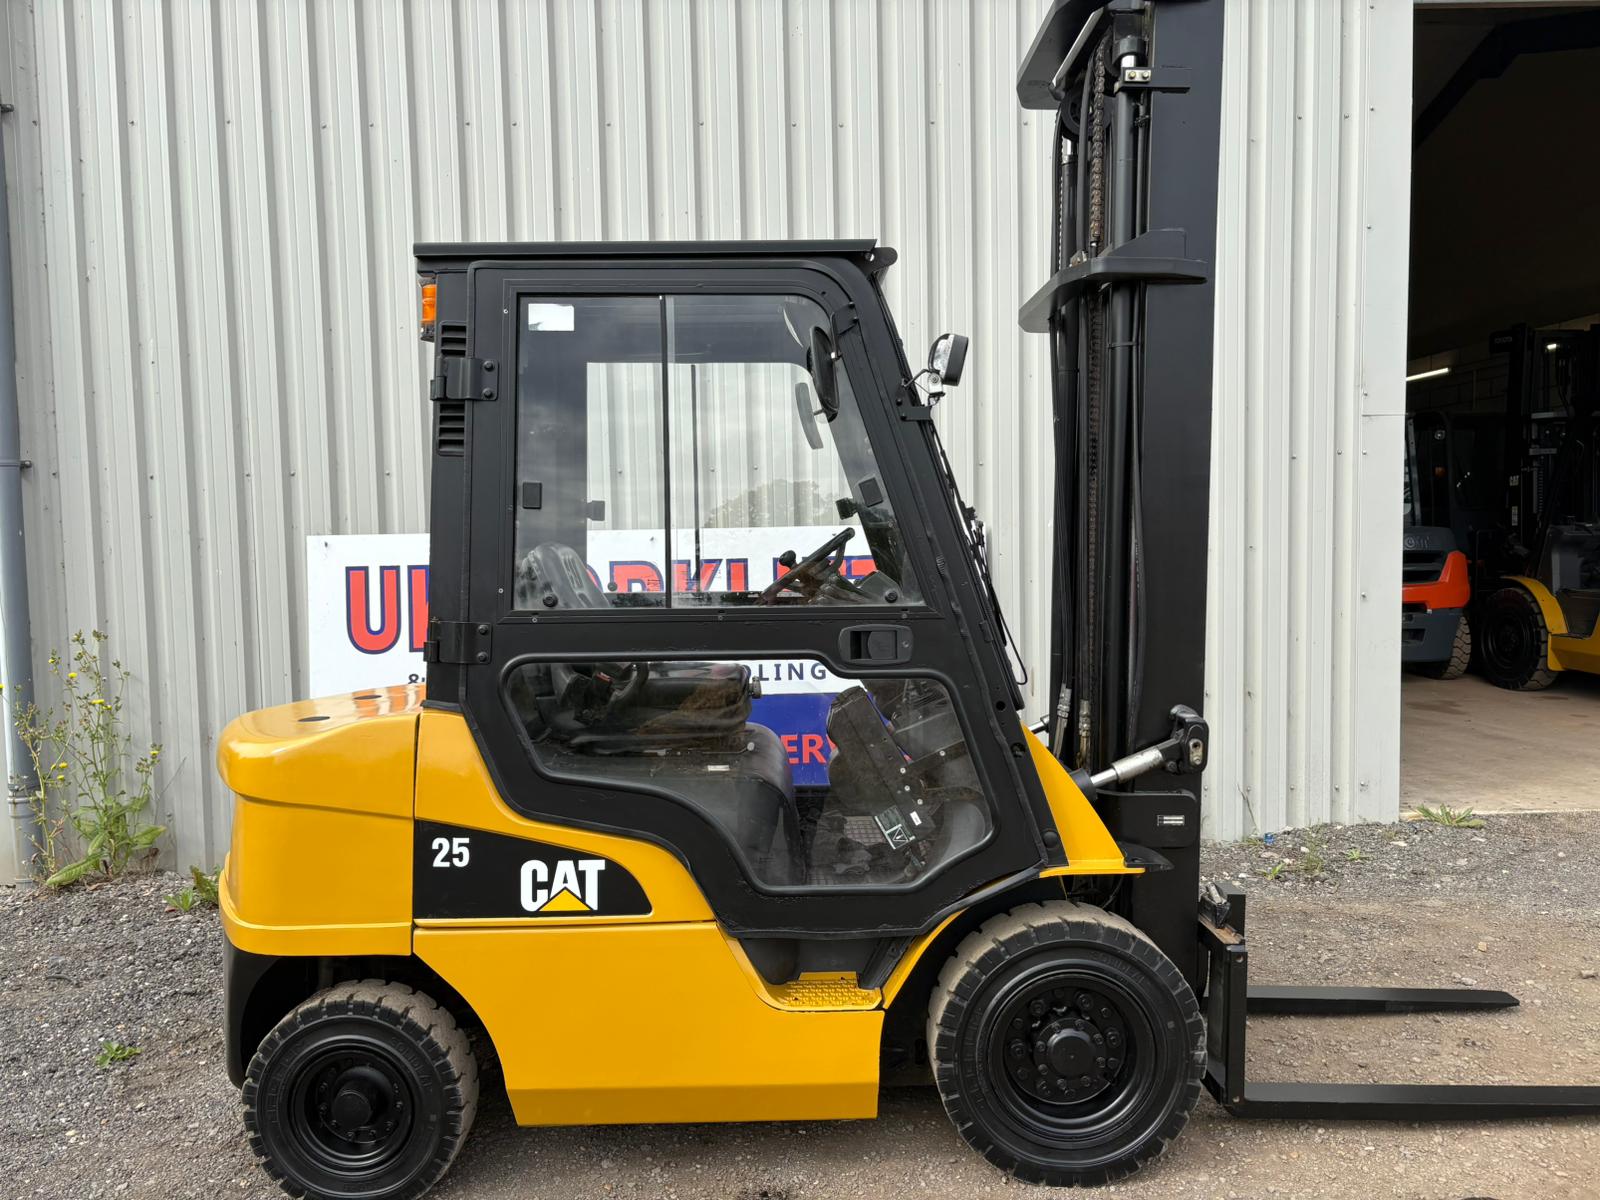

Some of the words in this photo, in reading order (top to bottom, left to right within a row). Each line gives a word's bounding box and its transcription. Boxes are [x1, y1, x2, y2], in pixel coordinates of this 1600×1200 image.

[779, 732, 838, 765] ER
[431, 837, 471, 868] 25
[520, 859, 606, 912] CAT
